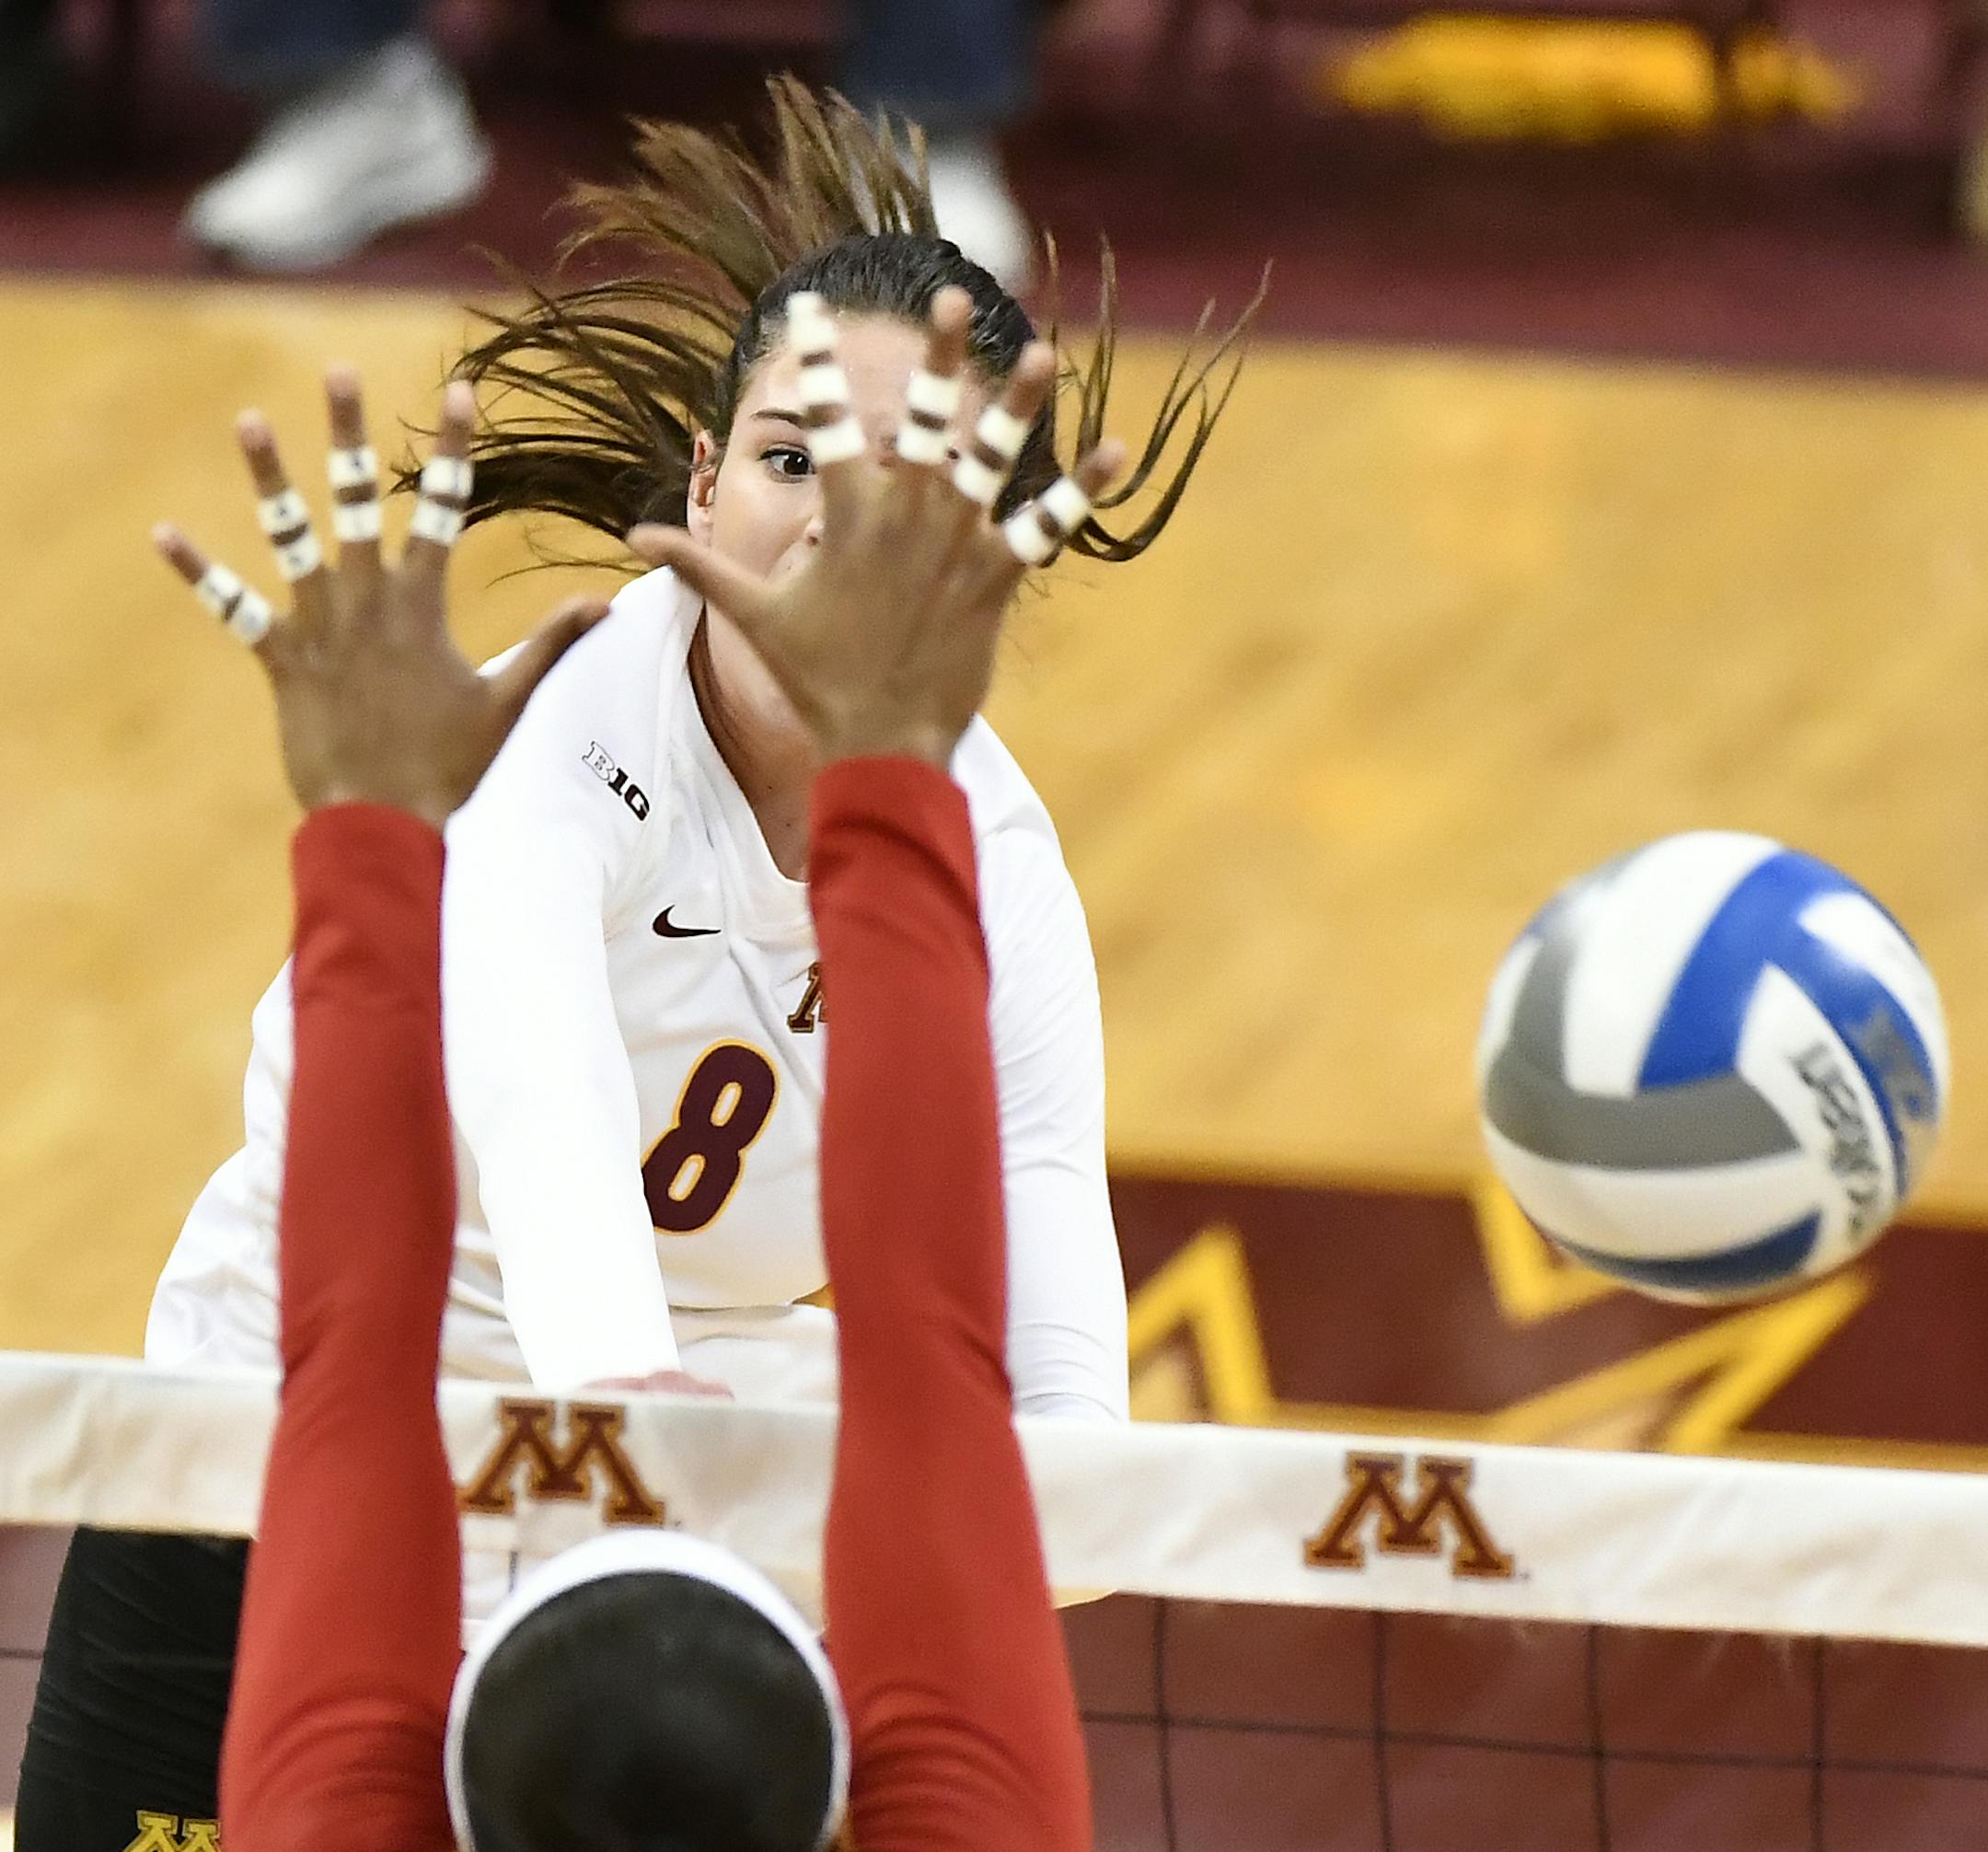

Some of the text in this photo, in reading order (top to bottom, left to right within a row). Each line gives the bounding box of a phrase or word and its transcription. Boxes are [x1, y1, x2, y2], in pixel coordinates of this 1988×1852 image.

[641, 1037, 780, 1237] 8
[459, 1397, 665, 1525] M
[1303, 1452, 1515, 1580] M
